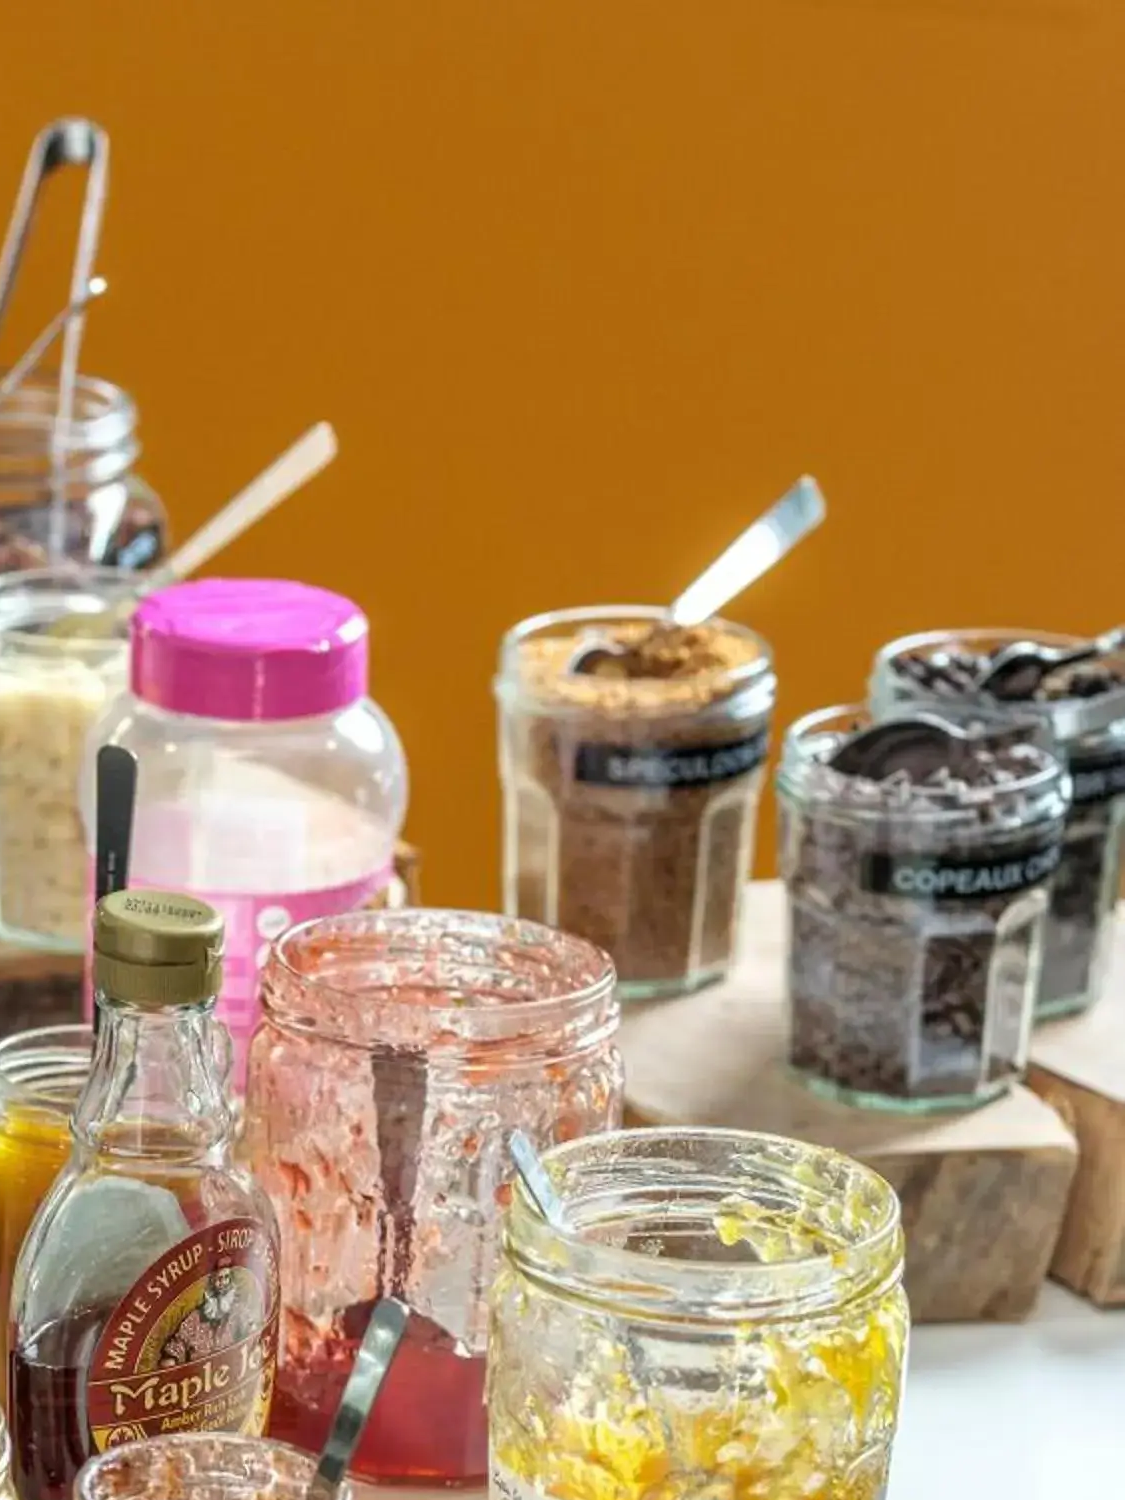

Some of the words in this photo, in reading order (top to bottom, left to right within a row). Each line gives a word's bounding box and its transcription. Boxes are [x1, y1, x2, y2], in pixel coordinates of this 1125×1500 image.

[891, 861, 1025, 895] COPEAUX
[104, 1296, 152, 1371] MAPLE
[147, 1243, 204, 1300] SYRUP
[110, 1360, 231, 1417] Maple
